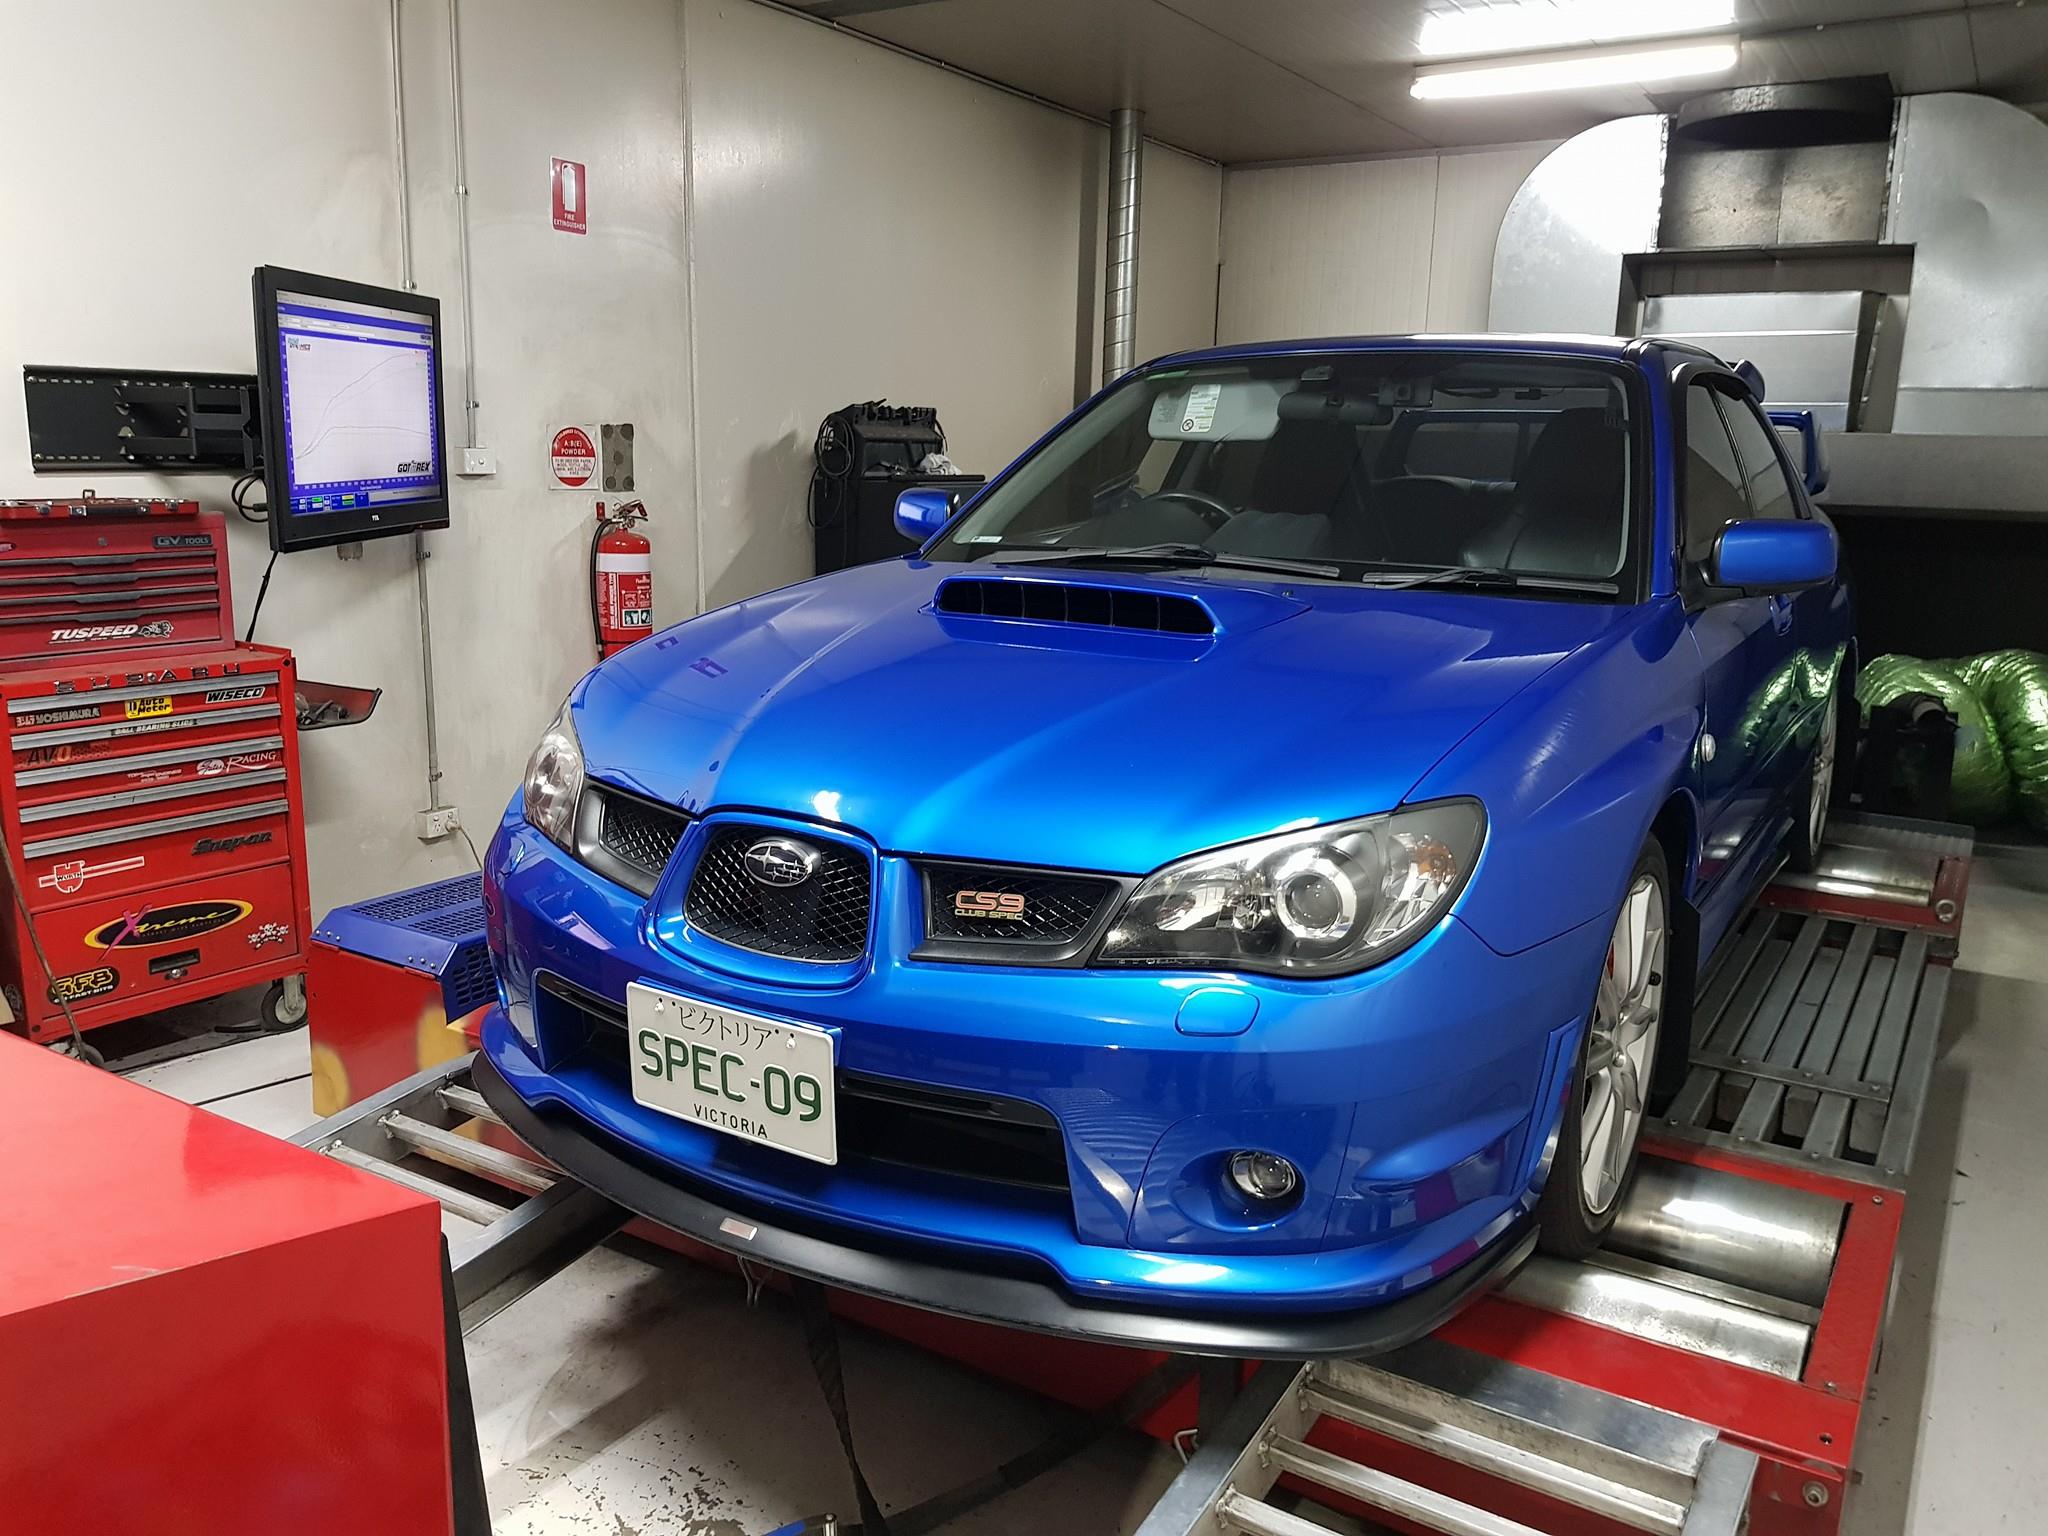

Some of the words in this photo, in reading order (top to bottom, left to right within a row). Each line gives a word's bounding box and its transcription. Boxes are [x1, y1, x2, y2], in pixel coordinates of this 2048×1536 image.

[157, 536, 180, 545] GV
[51, 624, 138, 641] TUSPEED
[207, 687, 263, 702] WISECO
[36, 707, 100, 724] YOSHIMURA
[955, 890, 1025, 913] CS9
[954, 909, 986, 918] CLUB
[988, 911, 1024, 921] SPEC
[69, 990, 92, 999] FAST
[93, 984, 114, 994] BITS
[679, 1004, 772, 1050] ビクトリア
[638, 1028, 822, 1122] SPEC-09
[693, 1103, 769, 1139] VICTORIA
